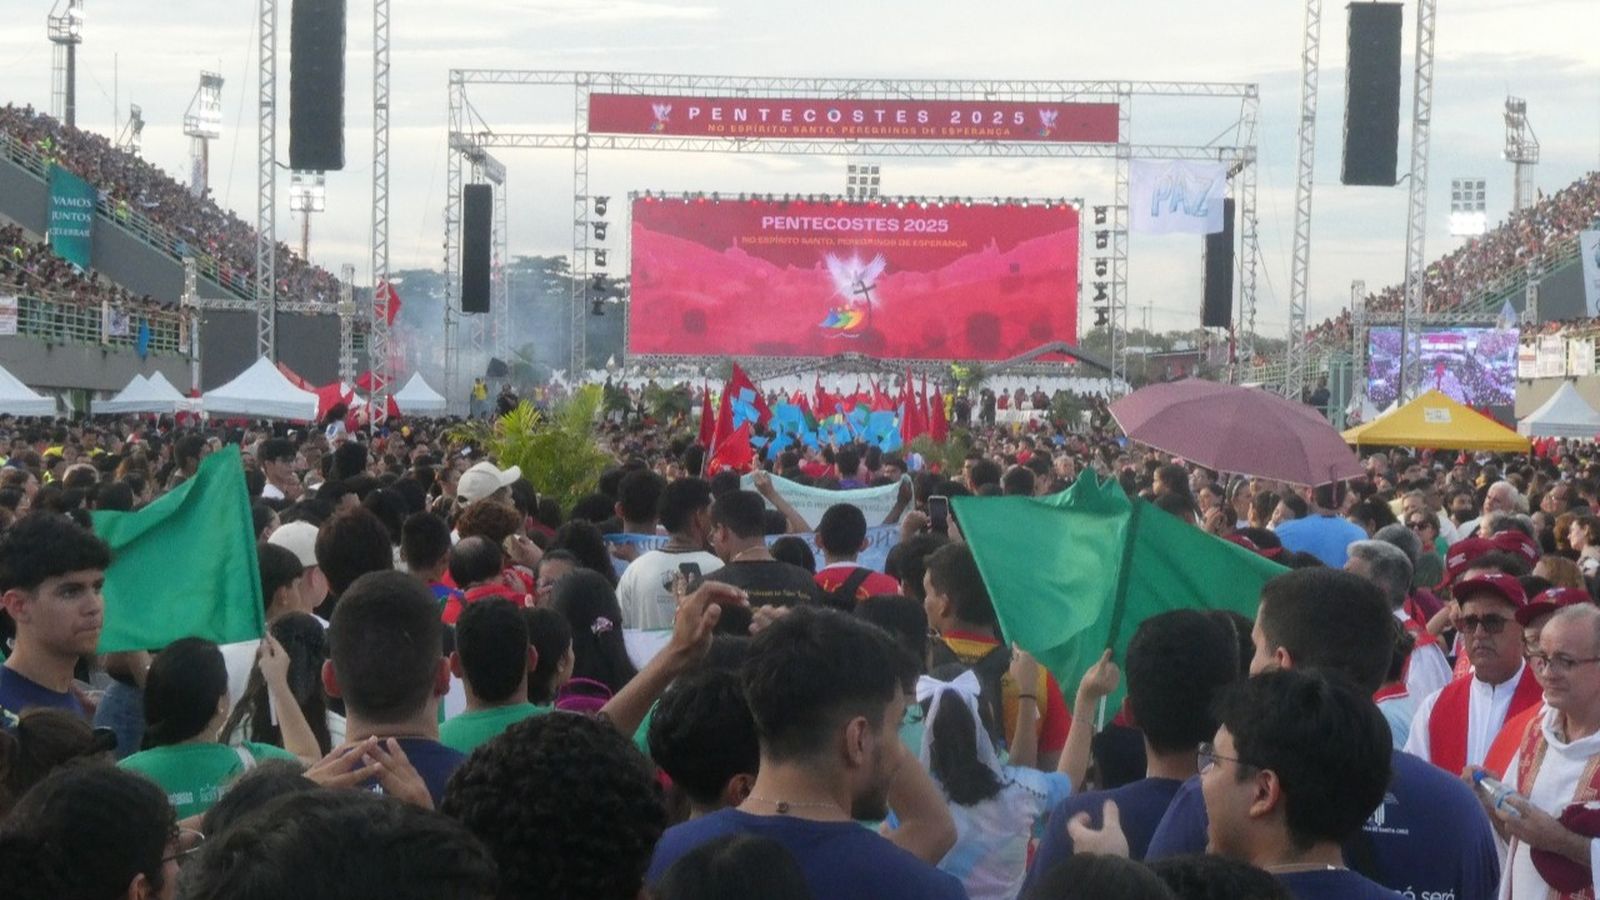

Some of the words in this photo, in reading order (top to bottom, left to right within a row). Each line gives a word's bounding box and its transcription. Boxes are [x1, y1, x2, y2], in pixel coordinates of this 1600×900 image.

[688, 107, 928, 123] PENTECOSTES
[950, 110, 1025, 125] 2025
[708, 124, 725, 132] NO
[842, 126, 917, 135] PEREGRINOS
[922, 127, 936, 135] DE
[942, 127, 1011, 137] ESPERANÇA
[53, 196, 92, 208] VAMOS
[1151, 175, 1214, 217] PAZ
[52, 211, 92, 222] JUNTOS
[762, 216, 899, 232] PENTECOSTES
[904, 218, 949, 233] 2025
